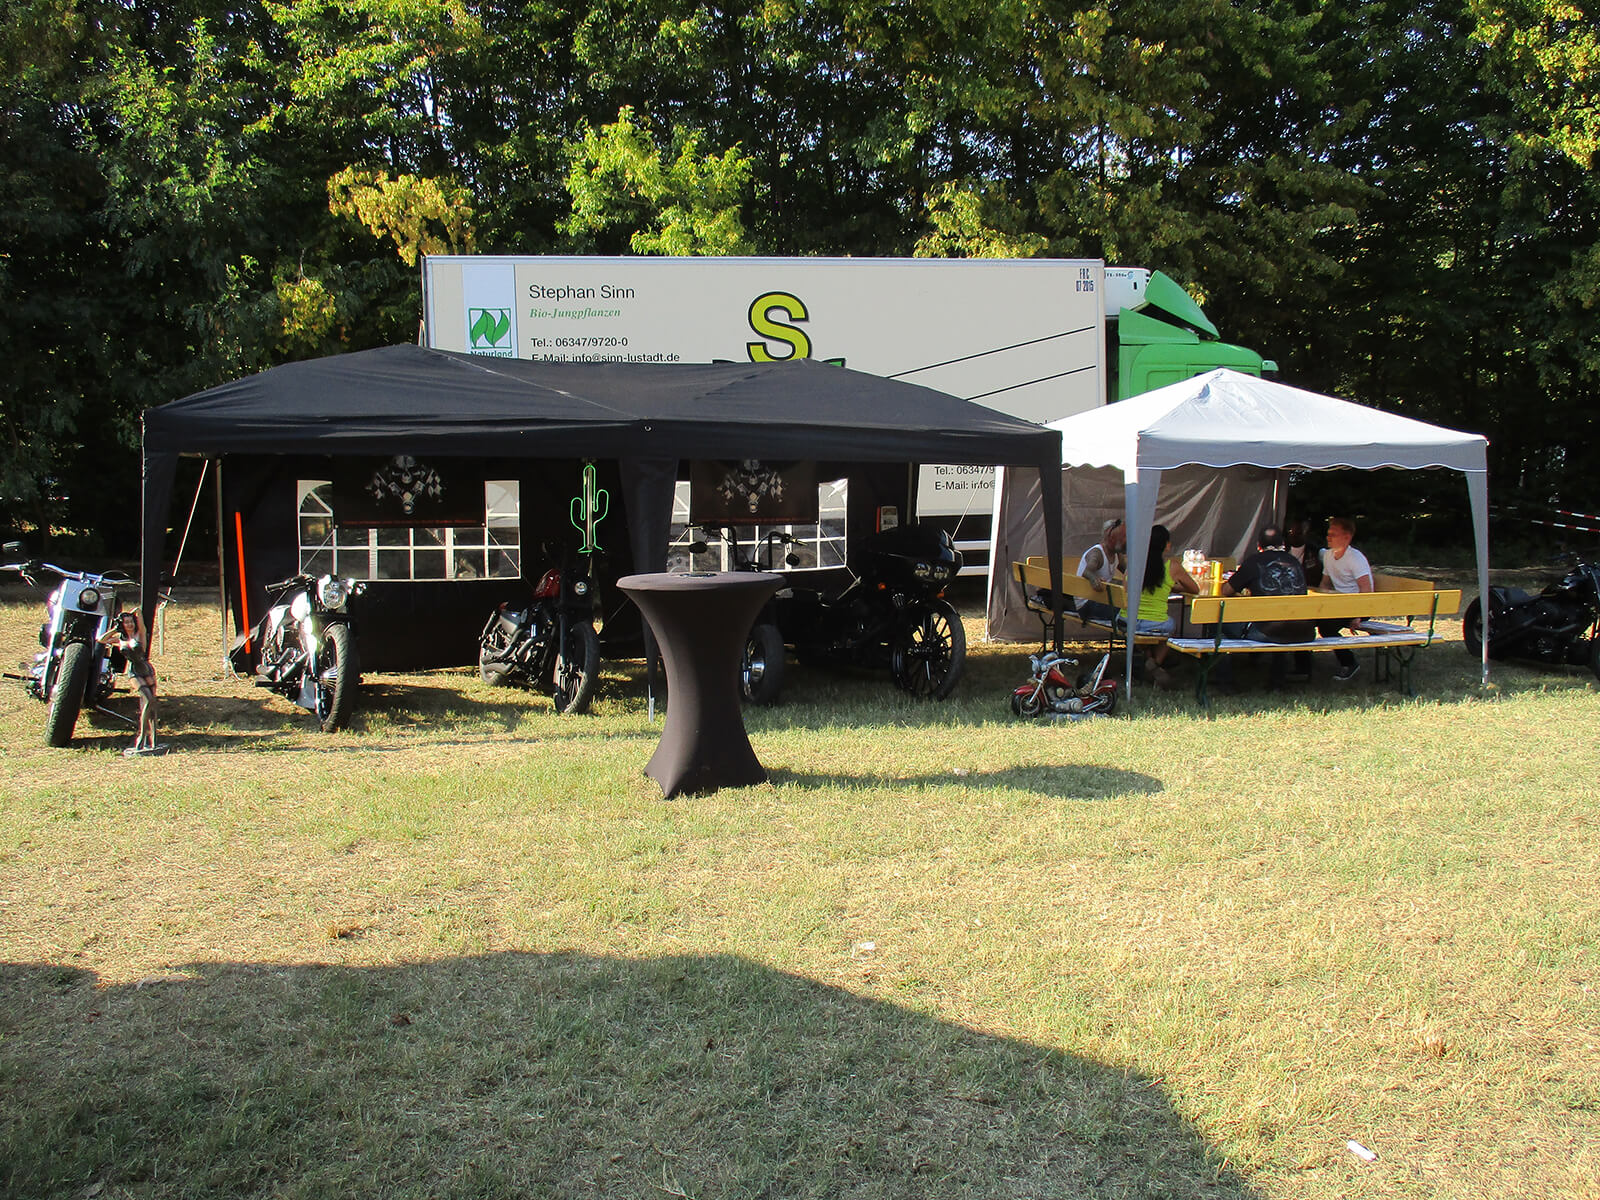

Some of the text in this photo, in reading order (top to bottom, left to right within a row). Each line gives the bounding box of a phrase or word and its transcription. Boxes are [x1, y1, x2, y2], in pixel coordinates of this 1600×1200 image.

[1082, 280, 1094, 292] 2015
[529, 284, 635, 302] Stephan Sinn
[529, 307, 621, 319] Bio-Jungpflanzen
[746, 290, 812, 362] S
[530, 337, 629, 348] Tel.: 06347/9720-0
[531, 353, 680, 363] E-Mail: info@sinn-lustadt.de
[934, 466, 954, 475] Tel.:
[935, 481, 969, 491] E-Mail:
